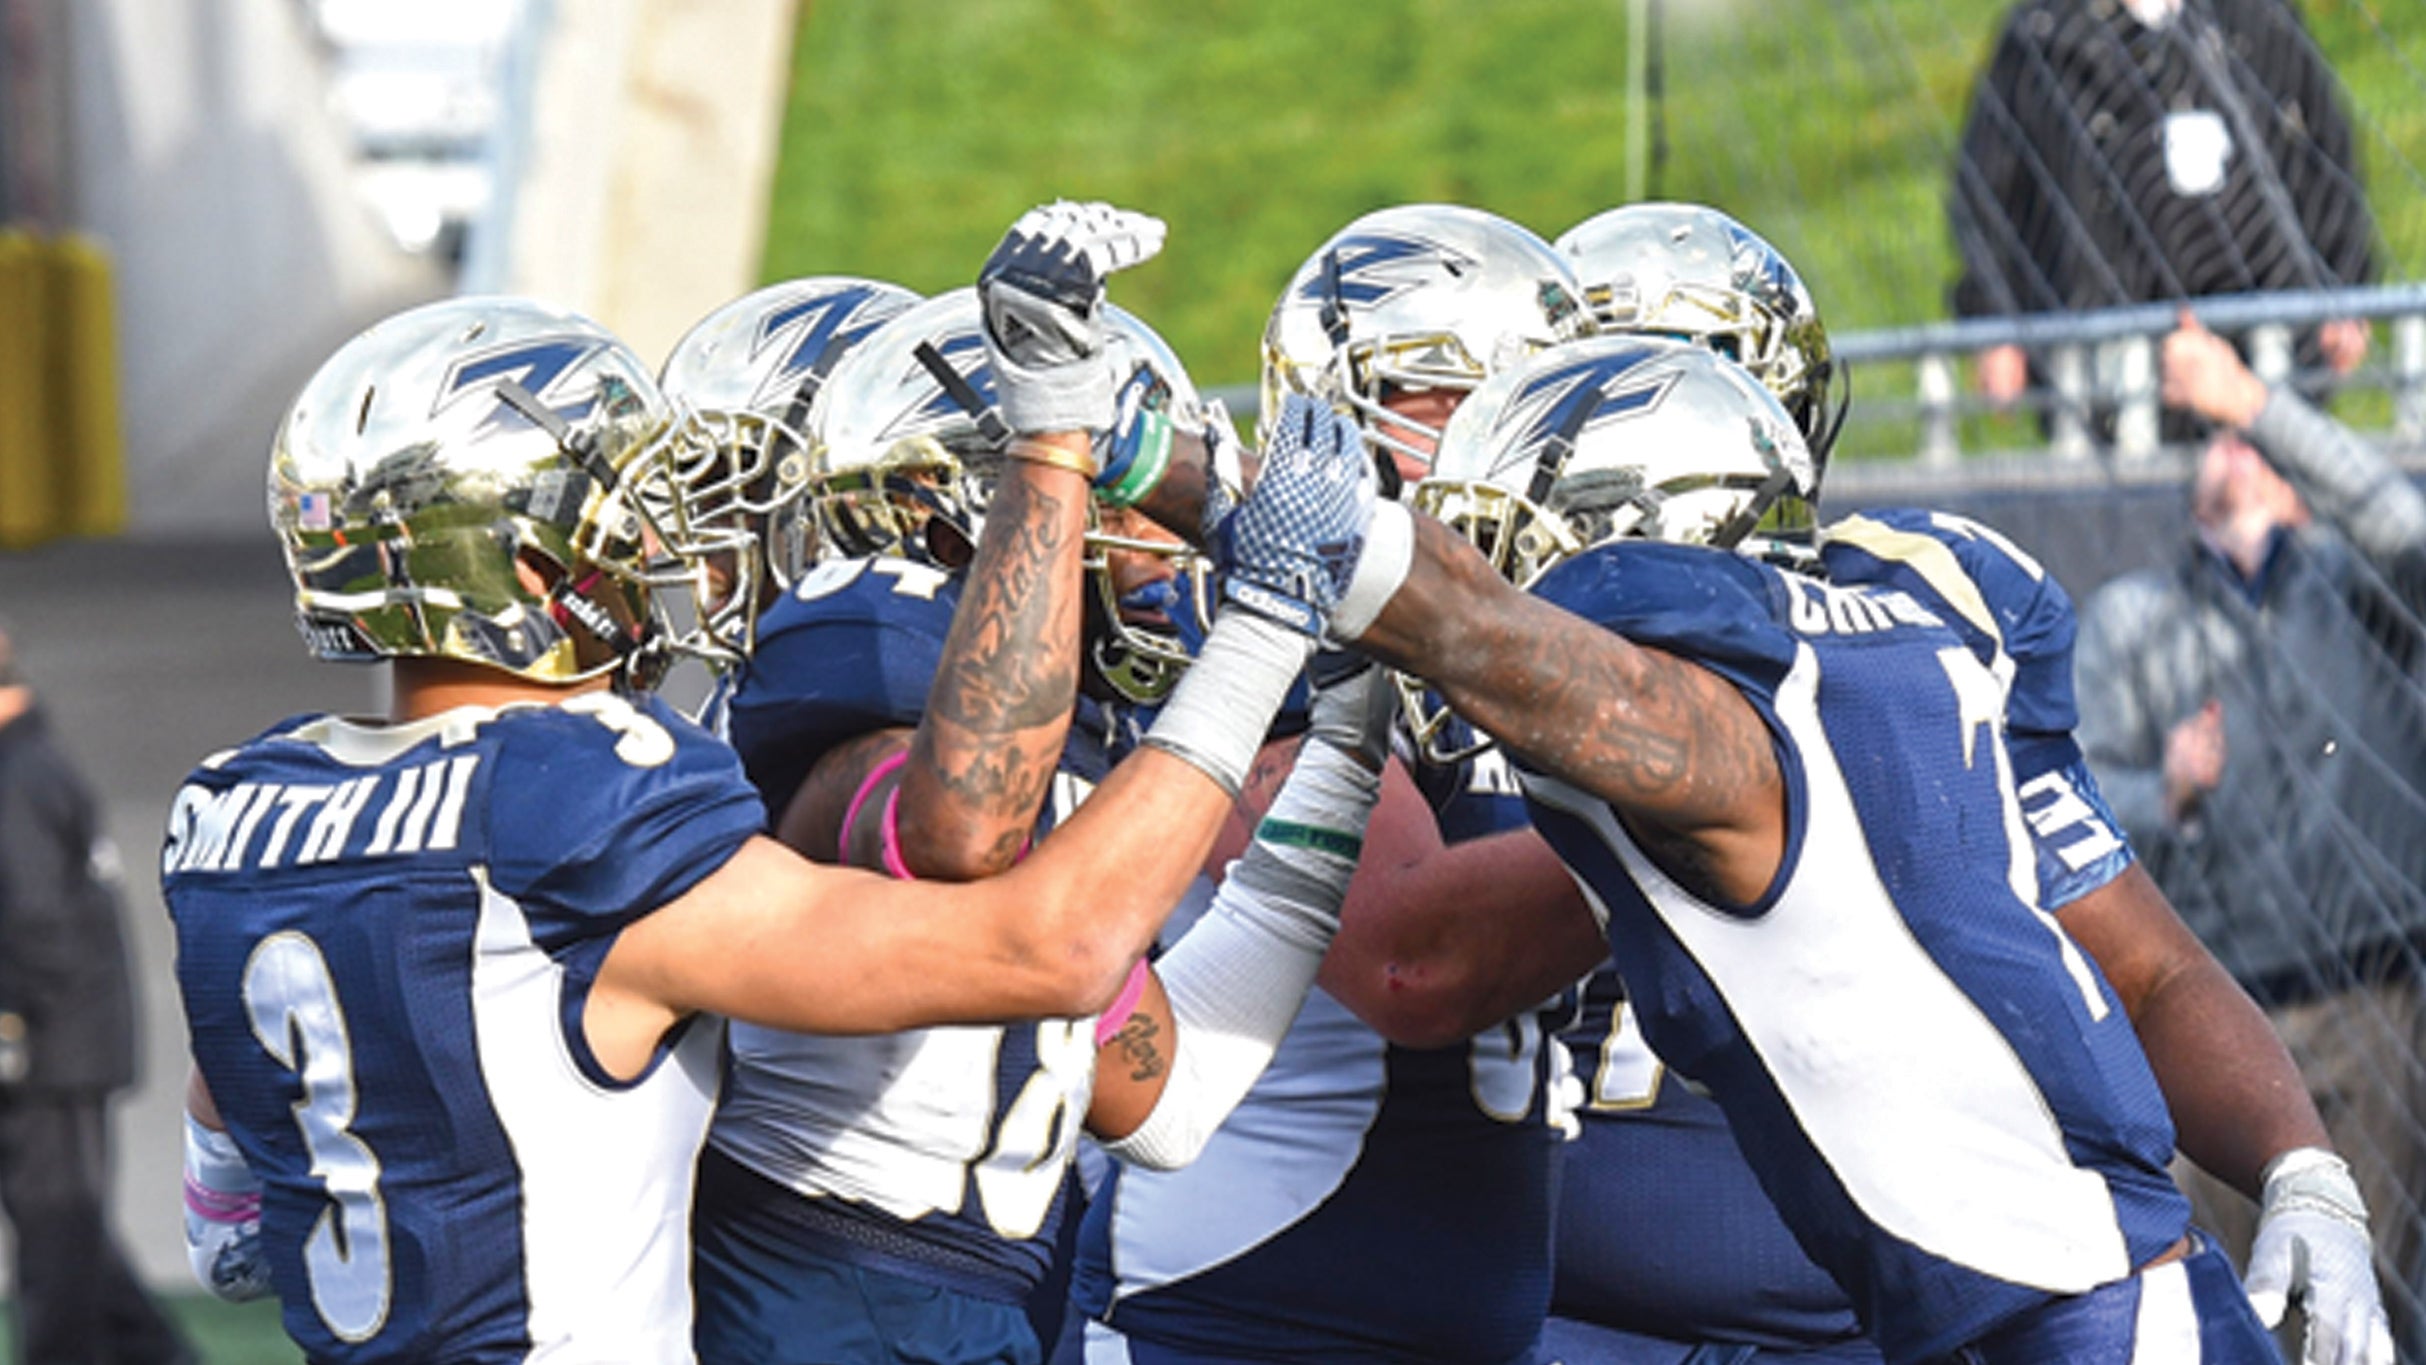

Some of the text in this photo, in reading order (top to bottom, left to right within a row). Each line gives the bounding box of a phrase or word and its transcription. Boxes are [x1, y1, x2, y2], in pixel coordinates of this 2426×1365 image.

[163, 755, 480, 874] SMITH III
[242, 929, 393, 1343] 3
